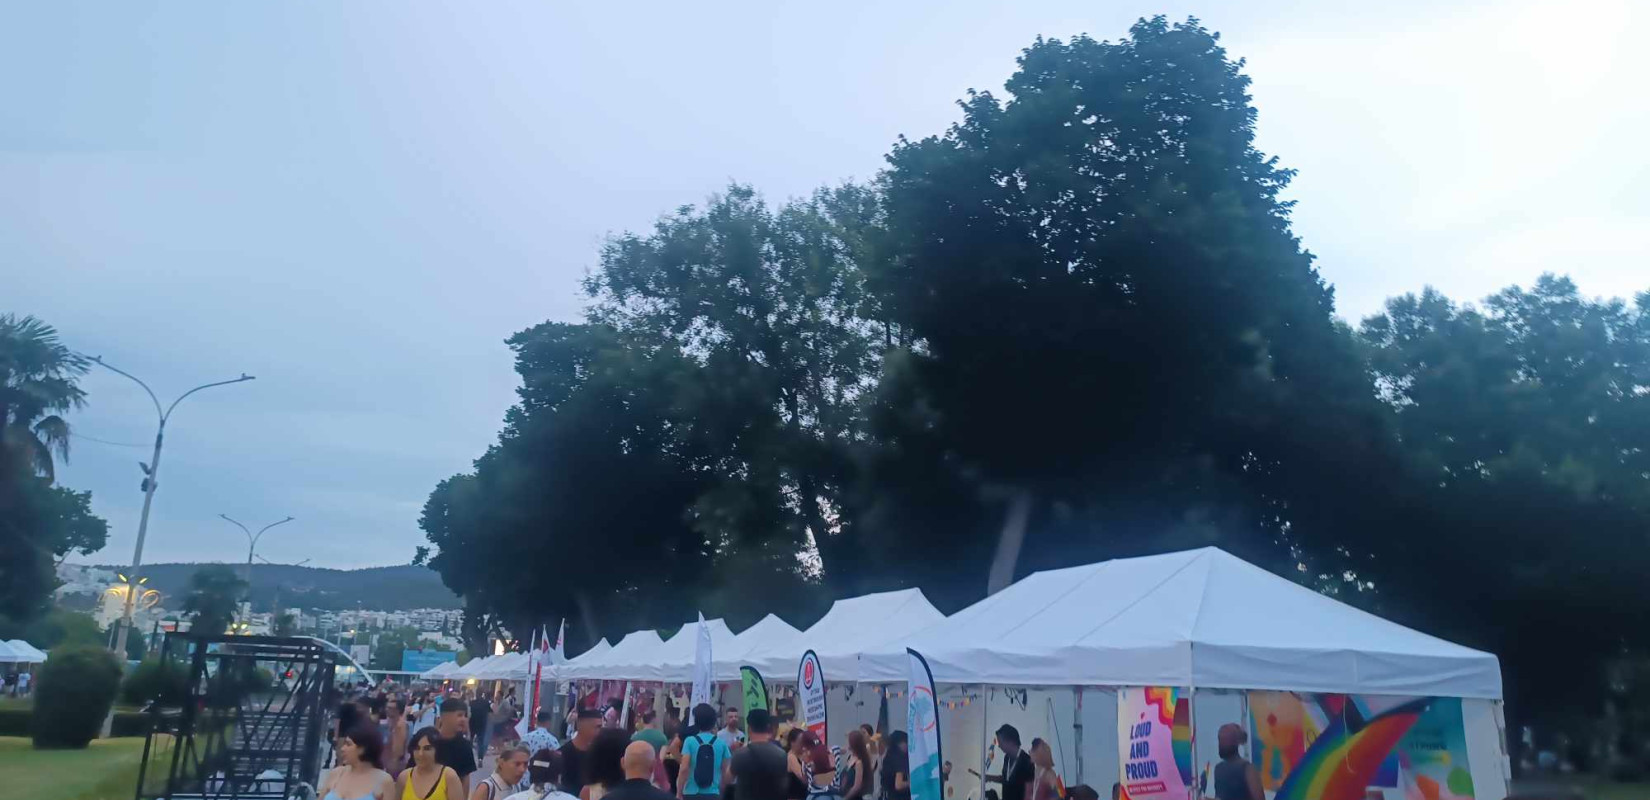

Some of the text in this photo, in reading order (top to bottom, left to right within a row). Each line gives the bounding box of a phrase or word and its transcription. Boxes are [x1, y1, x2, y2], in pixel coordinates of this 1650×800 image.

[1130, 721, 1151, 739] LOUD
[1130, 741, 1149, 759] AND
[1126, 761, 1158, 780] PROUD
